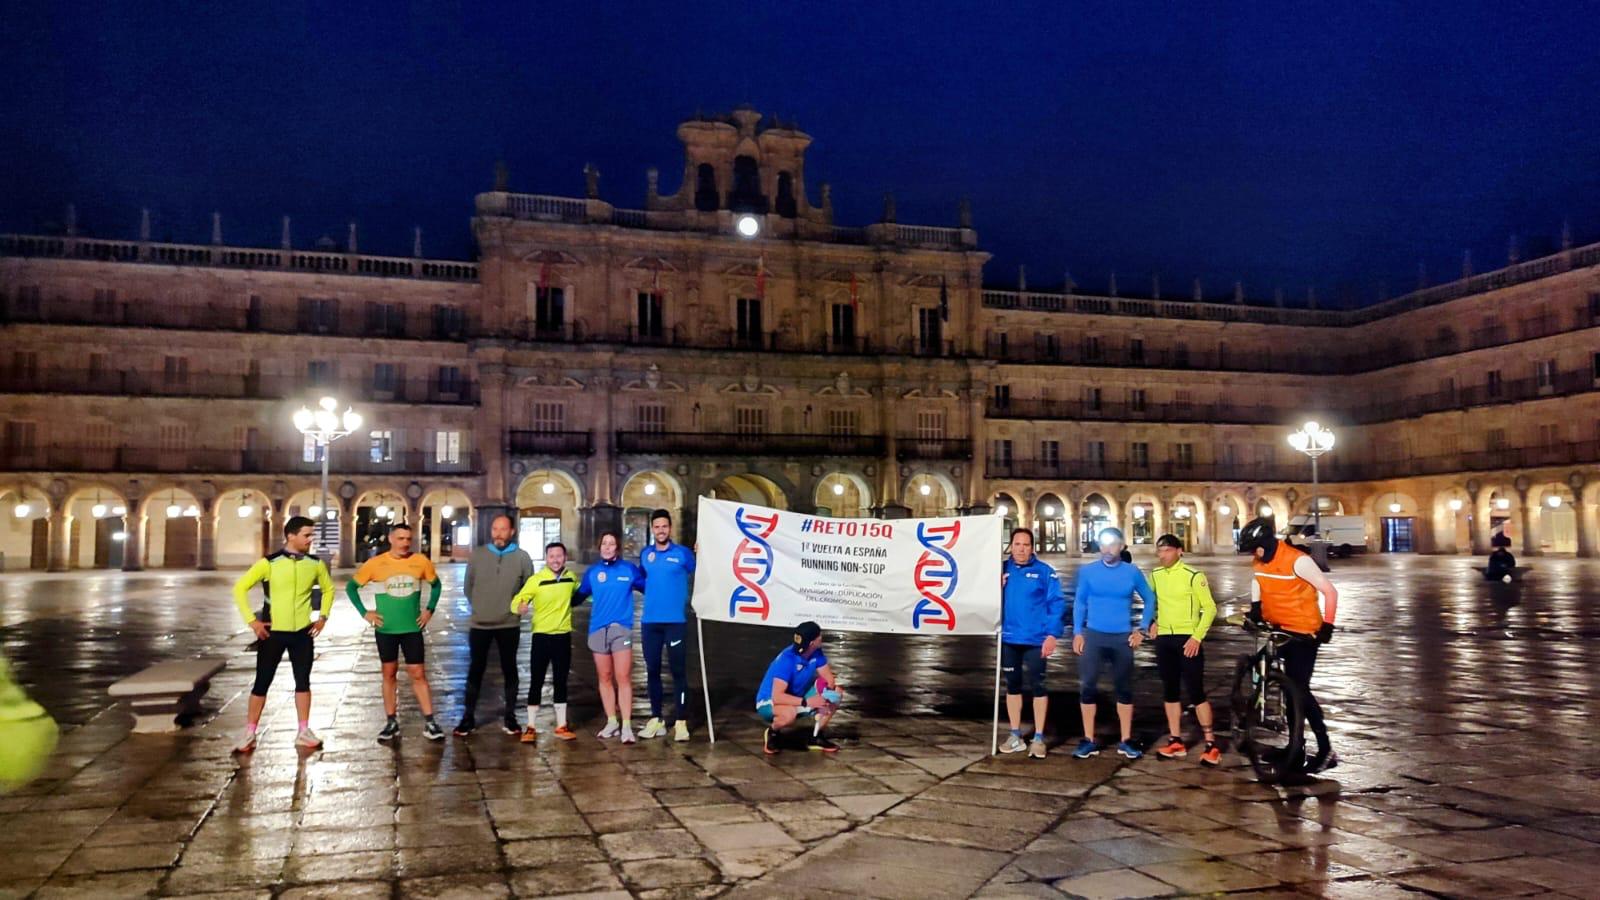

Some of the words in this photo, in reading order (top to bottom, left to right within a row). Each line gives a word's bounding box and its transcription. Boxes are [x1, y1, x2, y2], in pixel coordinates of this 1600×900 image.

[801, 518, 893, 539] #RETO15Q
[812, 543, 843, 555] VUELTA
[844, 546, 851, 556] A
[853, 545, 887, 558] ESPAÑA
[801, 558, 839, 571] RUNNING
[840, 561, 886, 575] NON-STOP
